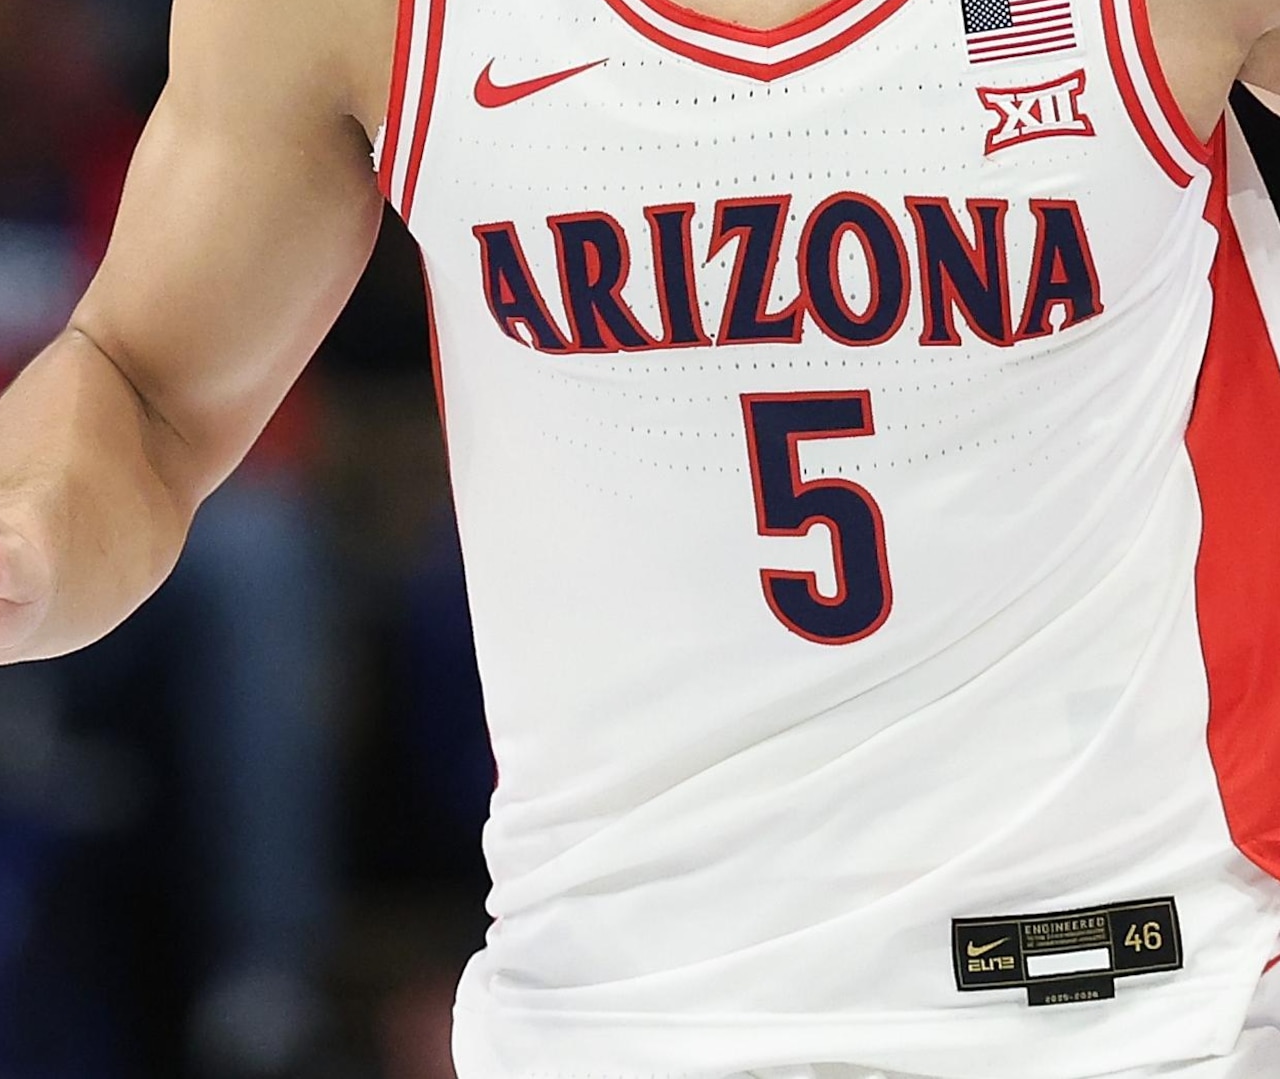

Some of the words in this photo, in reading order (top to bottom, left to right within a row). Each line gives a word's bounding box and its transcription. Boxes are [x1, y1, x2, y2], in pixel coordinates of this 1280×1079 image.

[979, 71, 1092, 153] XII
[472, 191, 1104, 353] ARIZONA
[740, 389, 892, 645] 5
[1024, 917, 1105, 935] ENGINEERED
[1124, 921, 1163, 953] 46
[968, 955, 1015, 973] ELITE
